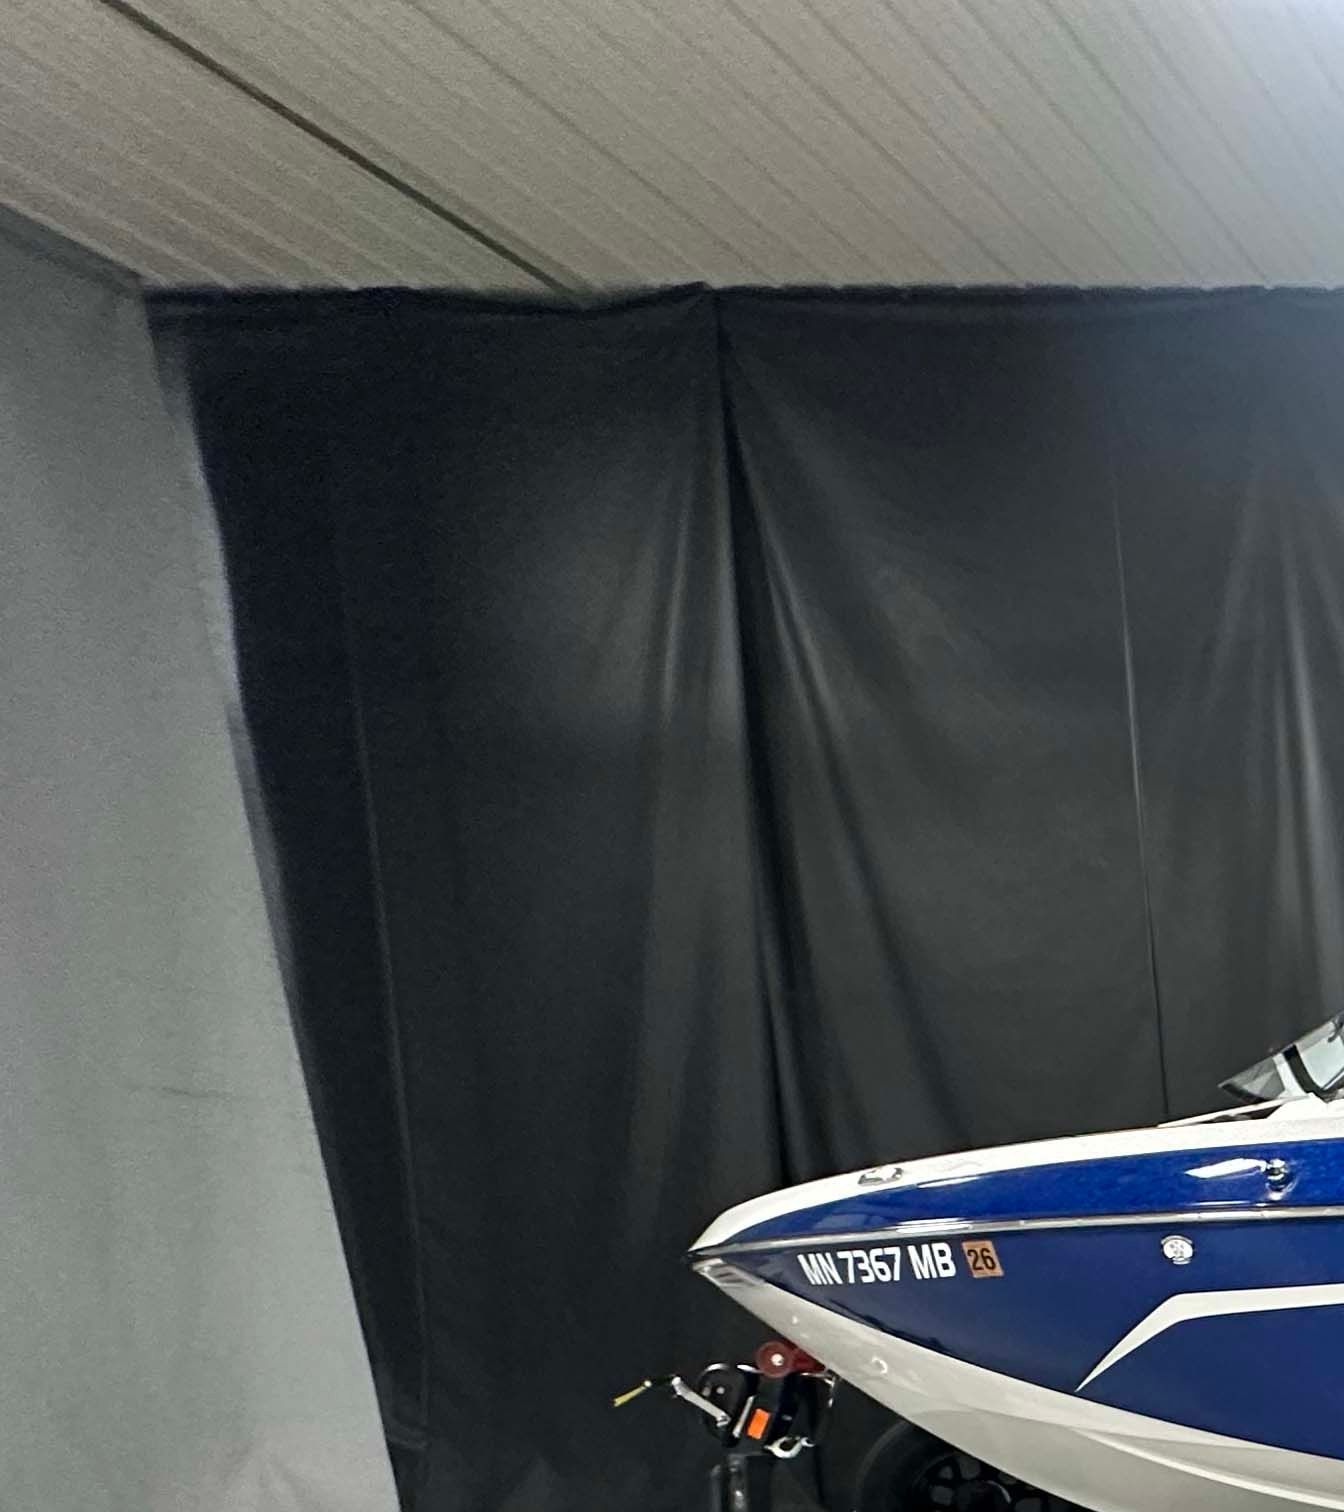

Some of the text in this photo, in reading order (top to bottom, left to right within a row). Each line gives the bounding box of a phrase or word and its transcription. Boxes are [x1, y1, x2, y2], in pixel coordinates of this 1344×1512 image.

[797, 1242, 957, 1285] MN 7367 MB
[967, 1248, 996, 1271] 26
